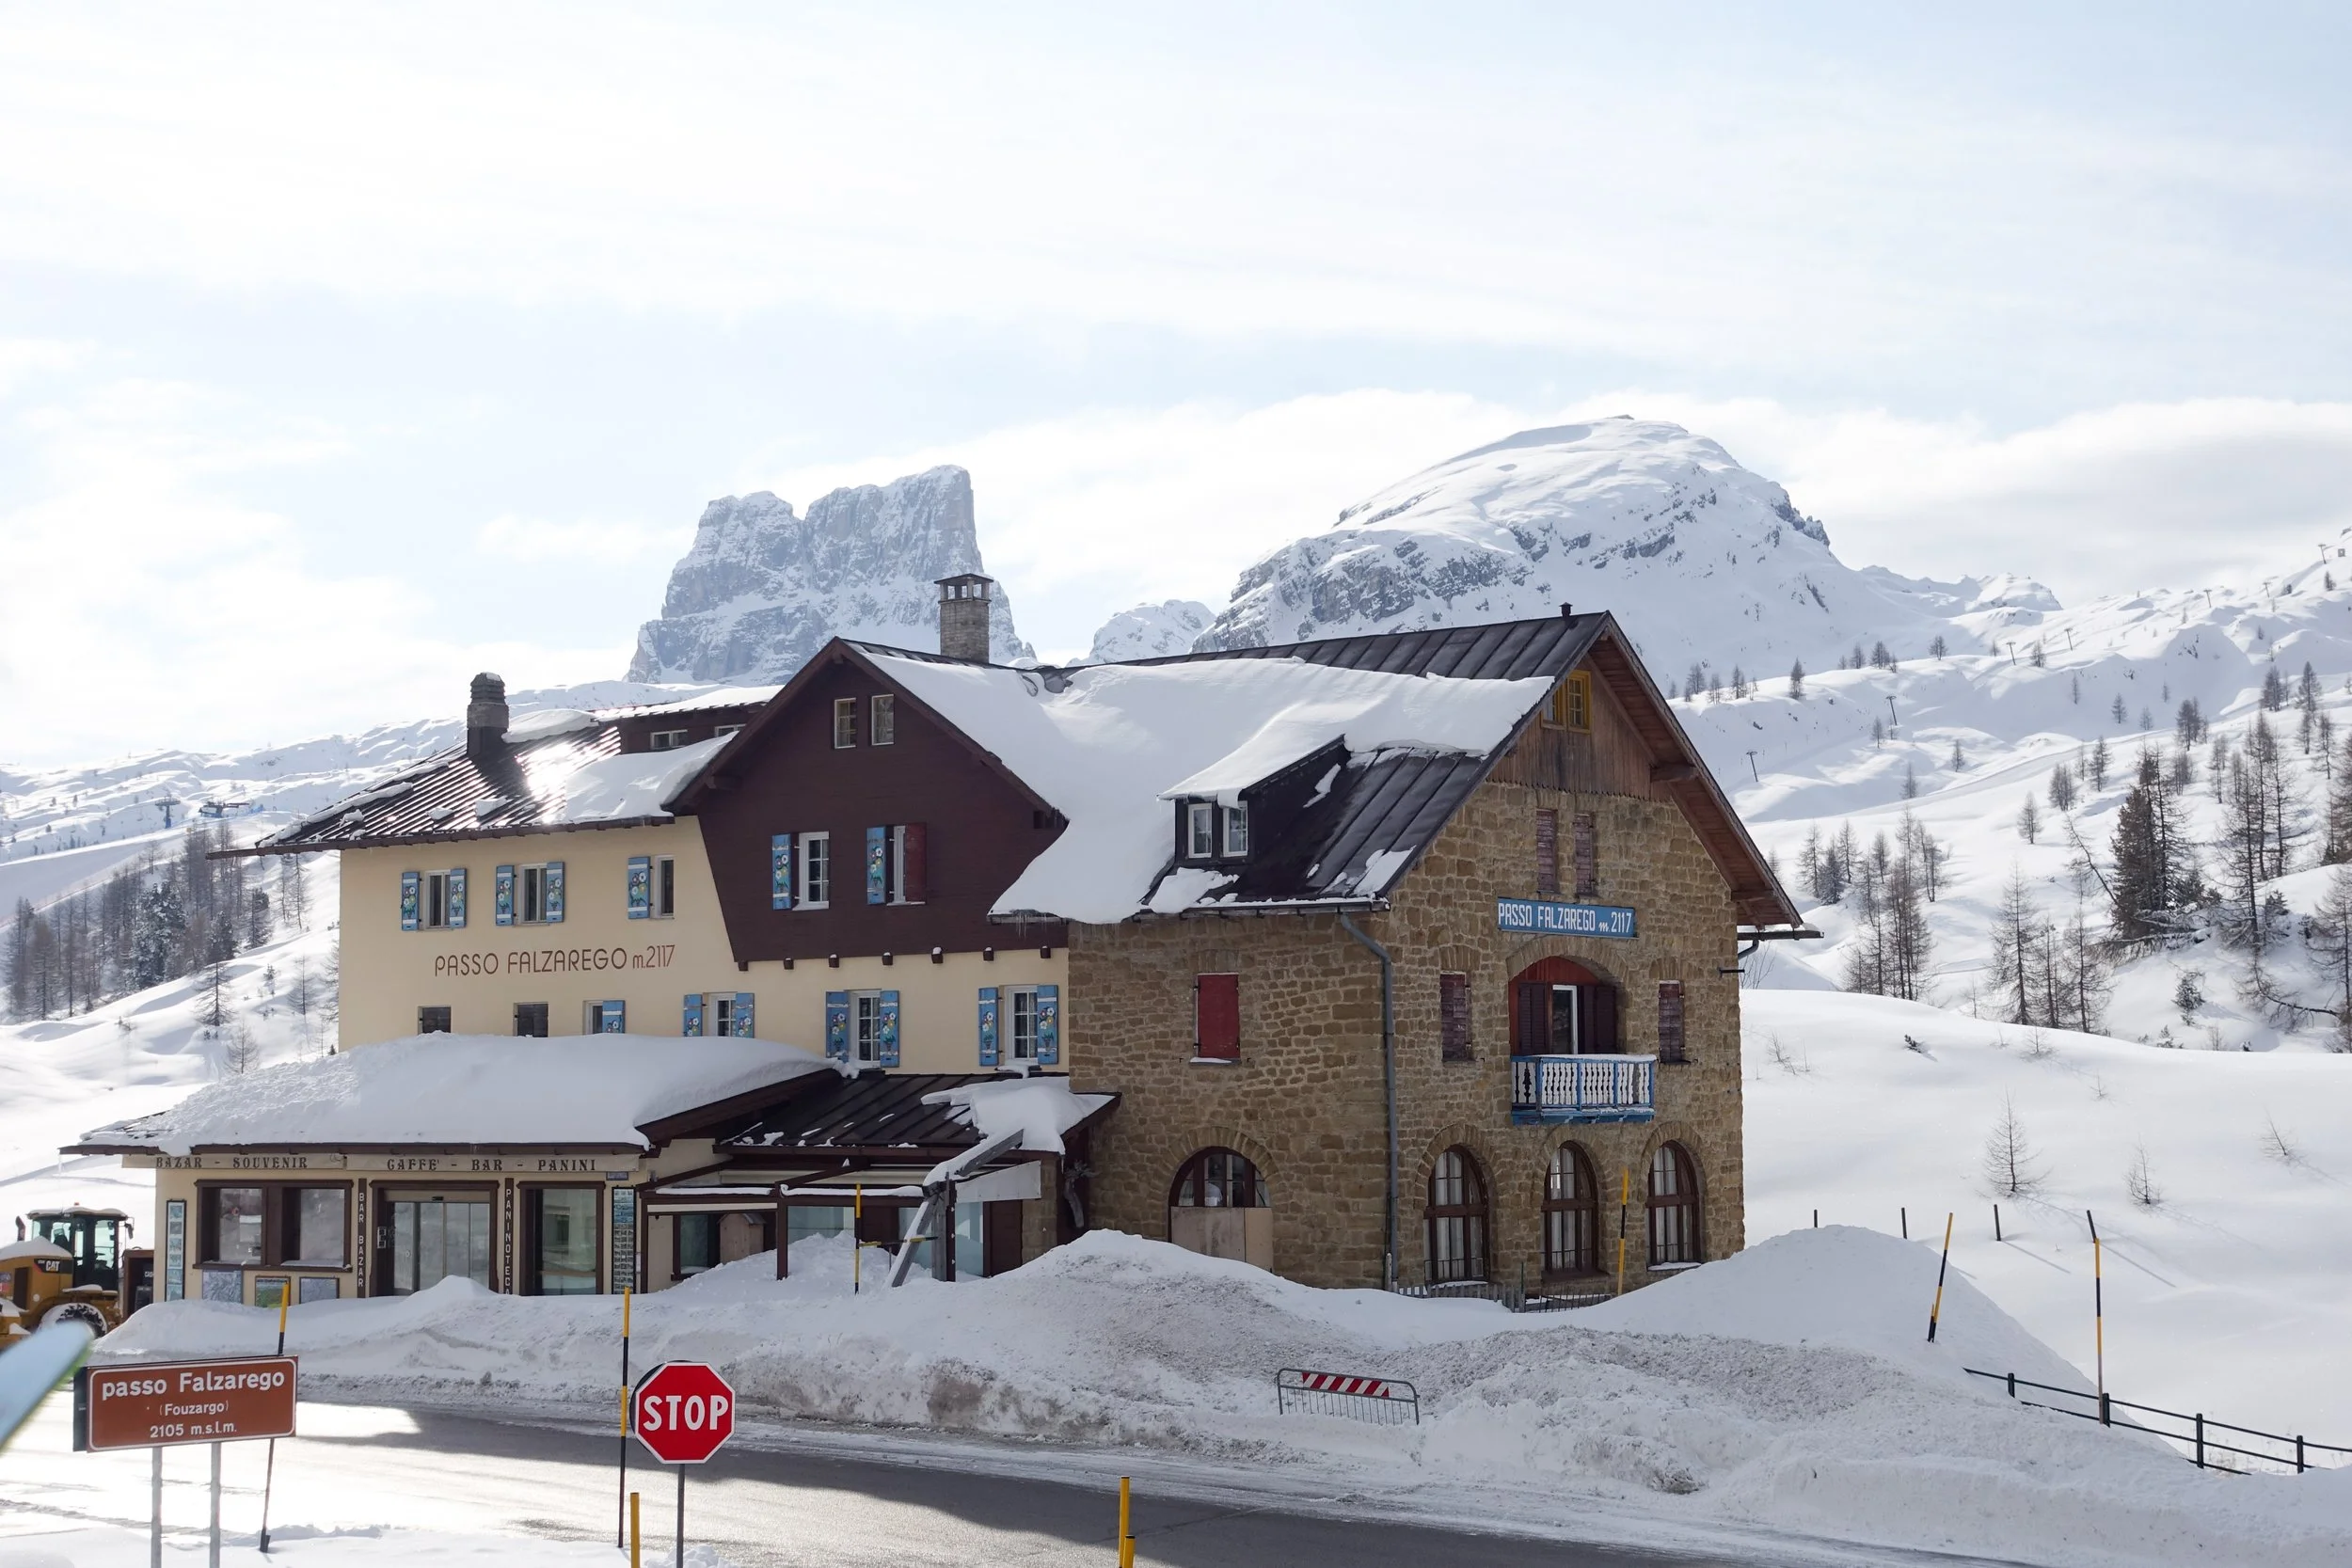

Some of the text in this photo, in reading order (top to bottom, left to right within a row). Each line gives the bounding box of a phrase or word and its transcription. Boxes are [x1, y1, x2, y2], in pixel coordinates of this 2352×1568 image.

[1498, 903, 1532, 927] PASSO
[1537, 906, 1596, 932] FALZAREGO
[435, 953, 499, 977] PASSO
[508, 947, 628, 974] FALZAREGO
[156, 1156, 202, 1168] BAZAR
[232, 1156, 308, 1169] SOUVENIR
[471, 1158, 502, 1171] BAR
[538, 1158, 596, 1171] PANINI
[45, 1259, 60, 1272] CAT
[102, 1371, 284, 1401] passo Falzarego
[643, 1395, 728, 1431] STOP
[150, 1423, 183, 1438] 2105
